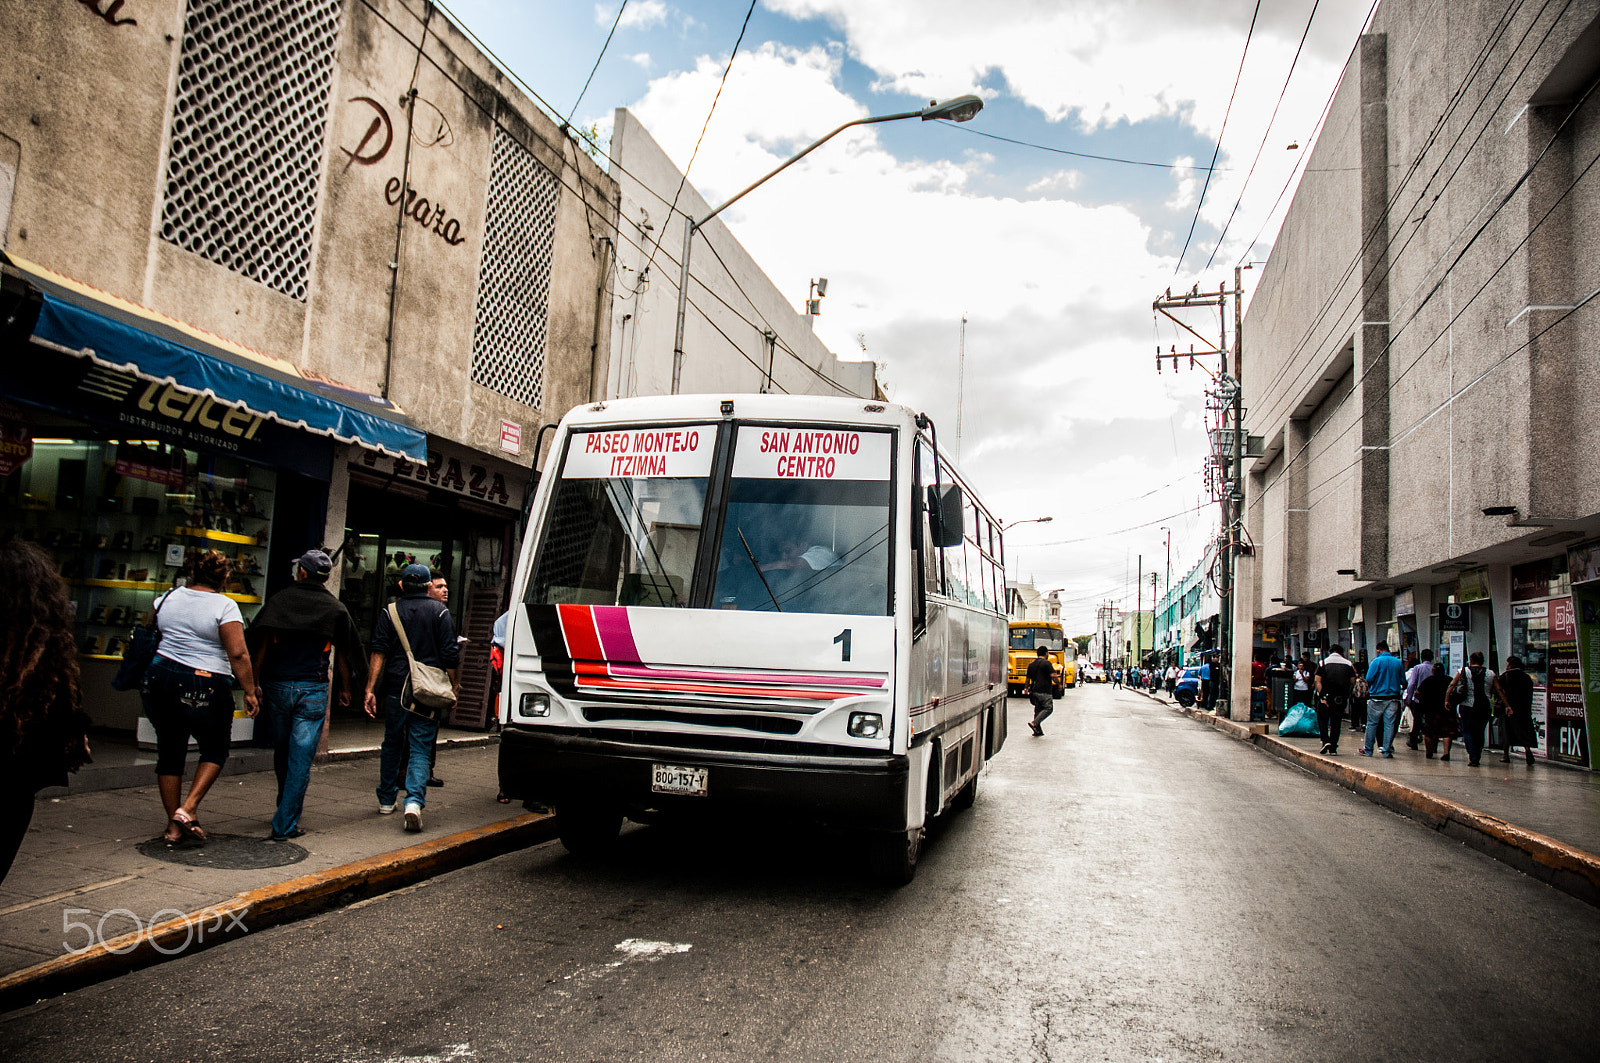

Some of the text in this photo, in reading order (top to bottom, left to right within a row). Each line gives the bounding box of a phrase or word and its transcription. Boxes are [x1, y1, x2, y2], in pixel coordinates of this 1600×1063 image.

[119, 412, 239, 451] DISTRIBUIDOR AUTORIZADO
[585, 430, 699, 454] PASEO MONTEJO
[760, 431, 860, 455] SAN ANTONIO
[610, 455, 667, 476] ITZIMNA
[777, 456, 836, 478] CENTRO
[833, 629, 852, 662] 1
[1551, 692, 1565, 702] PRECIO
[1556, 706, 1584, 718] MAYORISTAS
[1560, 726, 1582, 757] FIX
[655, 771, 705, 788] 800-157-Y
